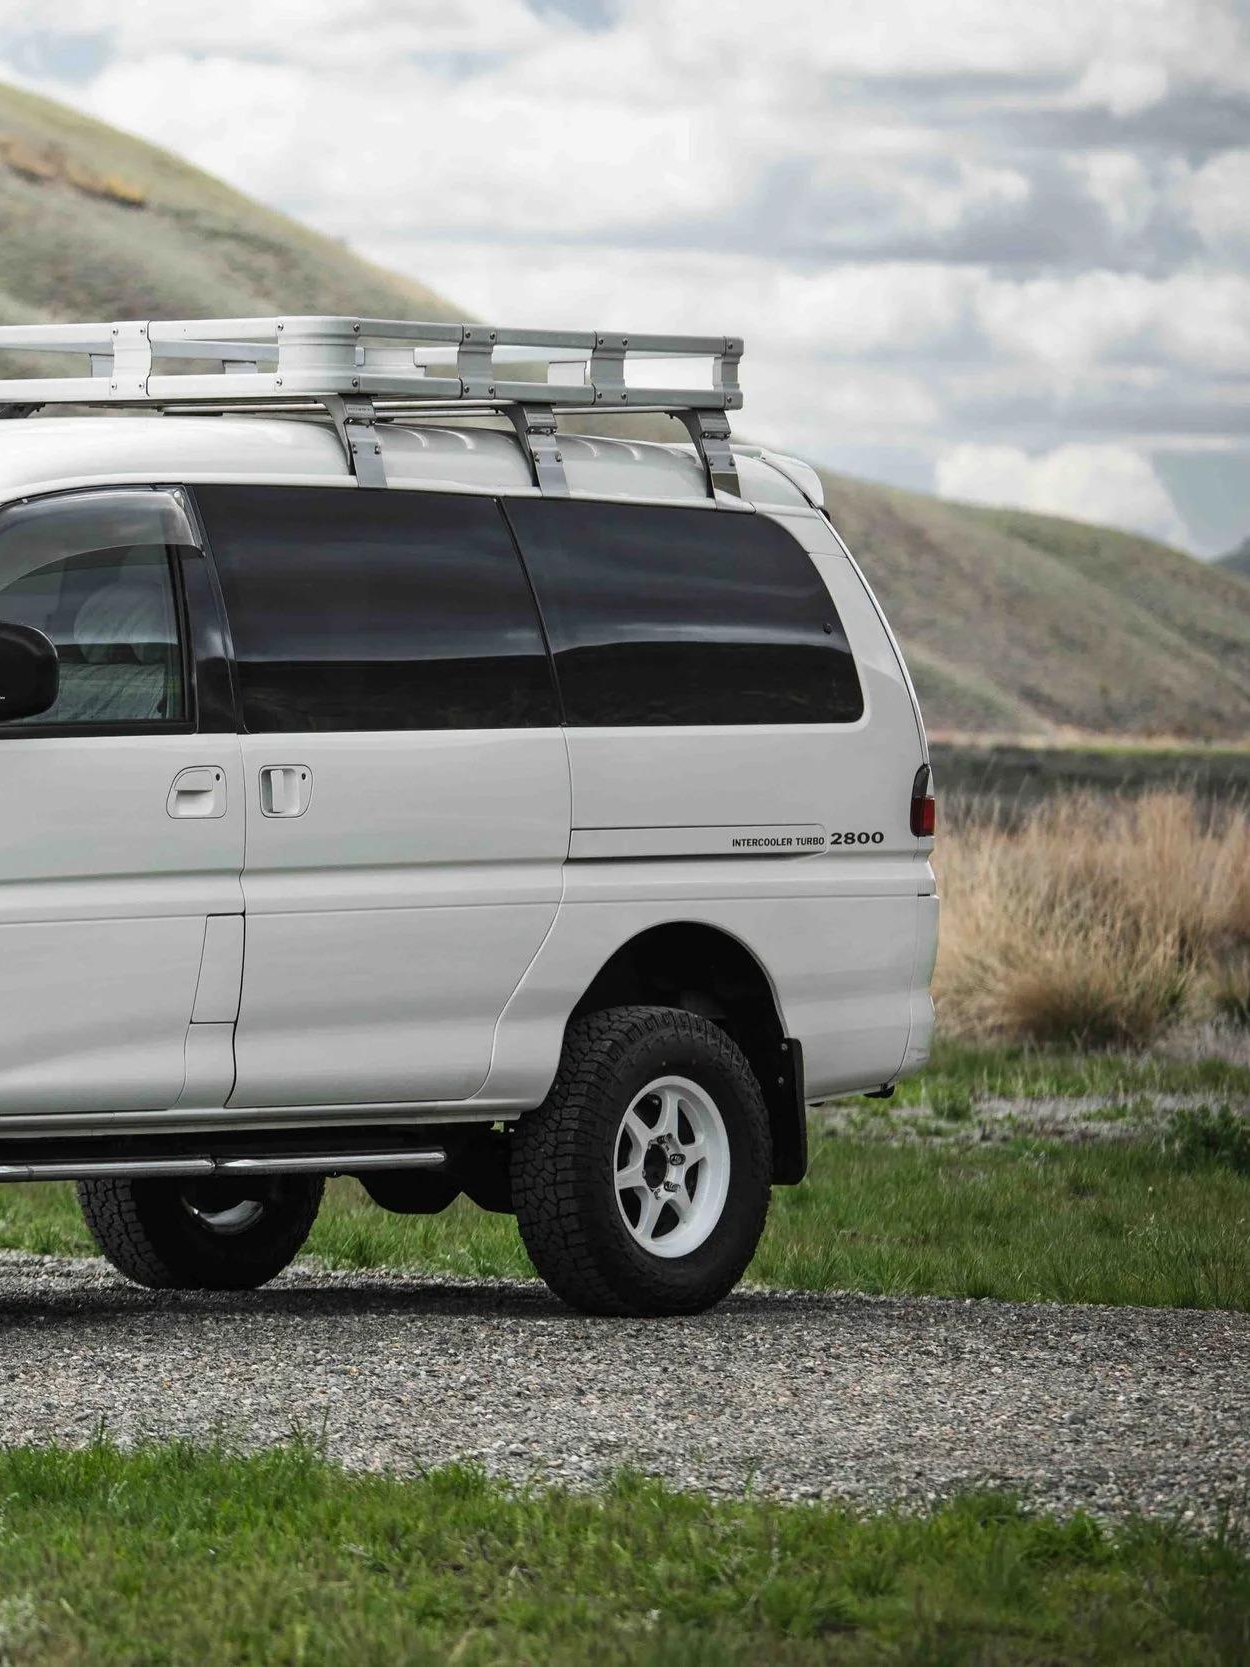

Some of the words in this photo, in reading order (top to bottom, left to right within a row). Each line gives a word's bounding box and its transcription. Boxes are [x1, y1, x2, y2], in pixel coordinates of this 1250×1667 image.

[732, 837, 793, 847] INTERCOOLER
[795, 836, 825, 846] TURBO
[830, 831, 885, 845] 2800
